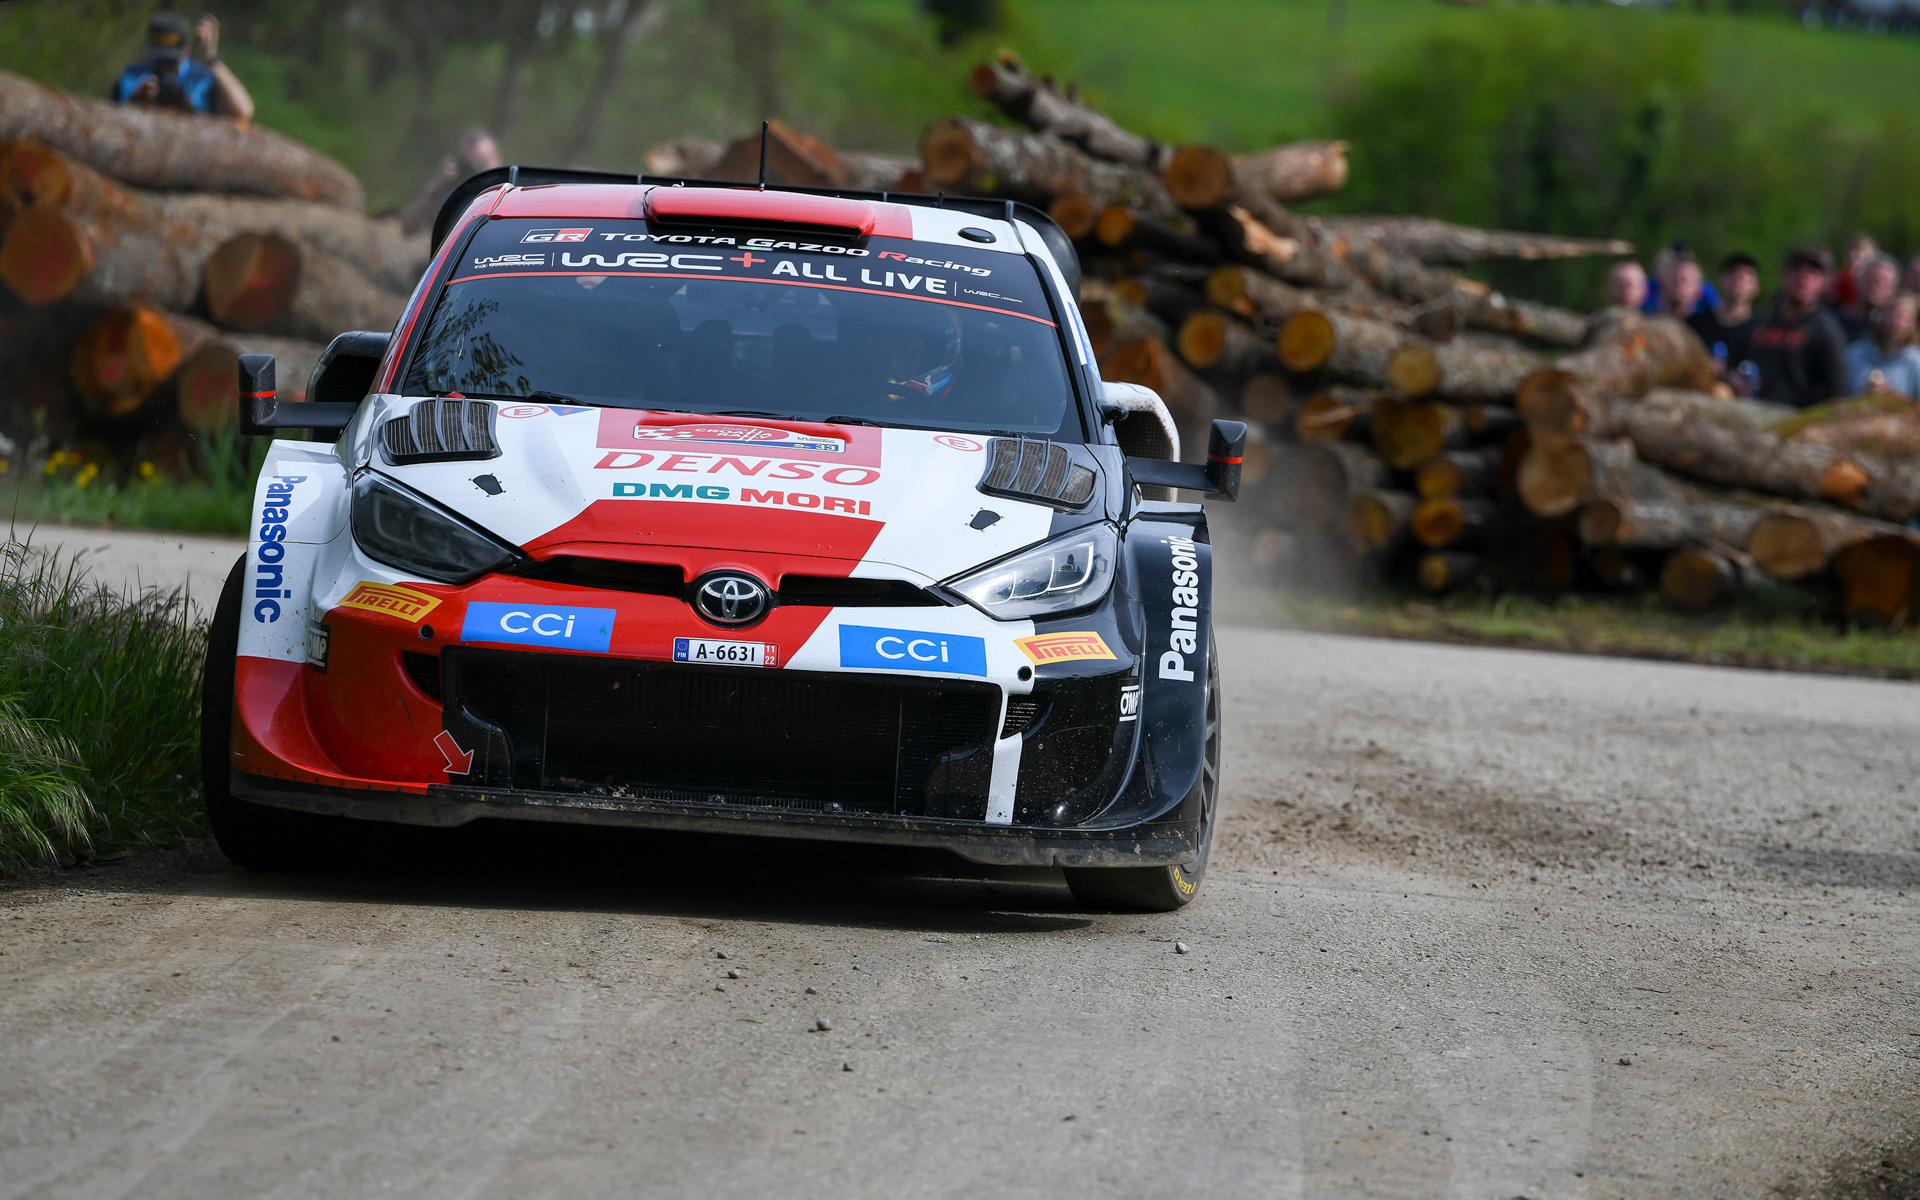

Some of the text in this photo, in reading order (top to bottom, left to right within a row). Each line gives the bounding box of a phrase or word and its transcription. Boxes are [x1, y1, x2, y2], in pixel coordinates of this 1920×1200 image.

[525, 232, 992, 277] GR TOYOTA GAZOO Racing
[772, 260, 848, 282] ALL
[861, 268, 948, 295] LIVE
[592, 450, 881, 486] DENSO
[612, 482, 871, 516] DMG MORI
[253, 475, 308, 624] Panasonic
[345, 585, 430, 617] PIRELLI
[1158, 535, 1199, 682] Panasonic
[764, 655, 775, 666] 22
[765, 645, 775, 654] 11
[1024, 636, 1107, 660] PIRELLI
